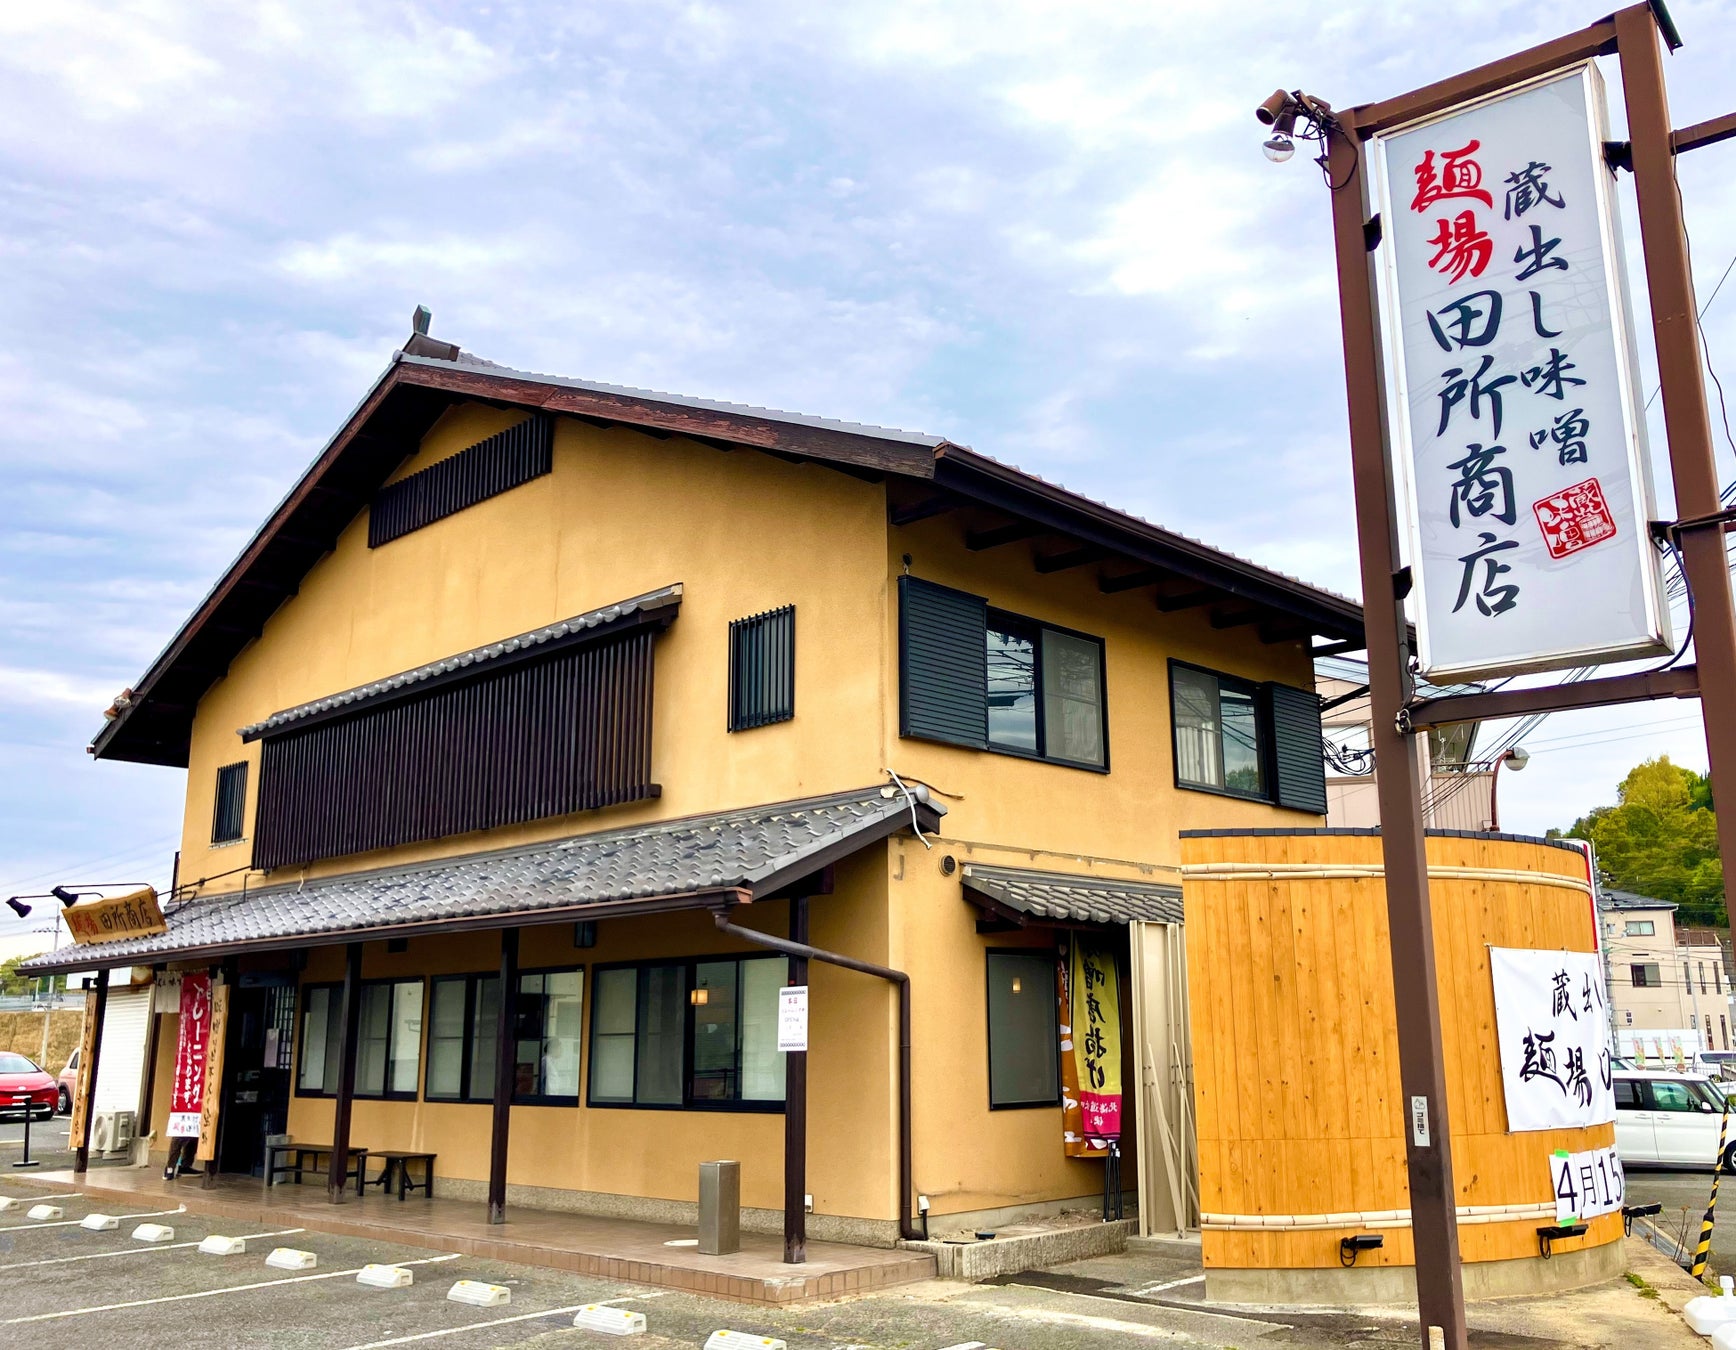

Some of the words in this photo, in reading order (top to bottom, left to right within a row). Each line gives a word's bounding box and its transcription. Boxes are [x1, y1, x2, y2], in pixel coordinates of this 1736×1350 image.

[1504, 161, 1590, 466] 蔵出し味噌
